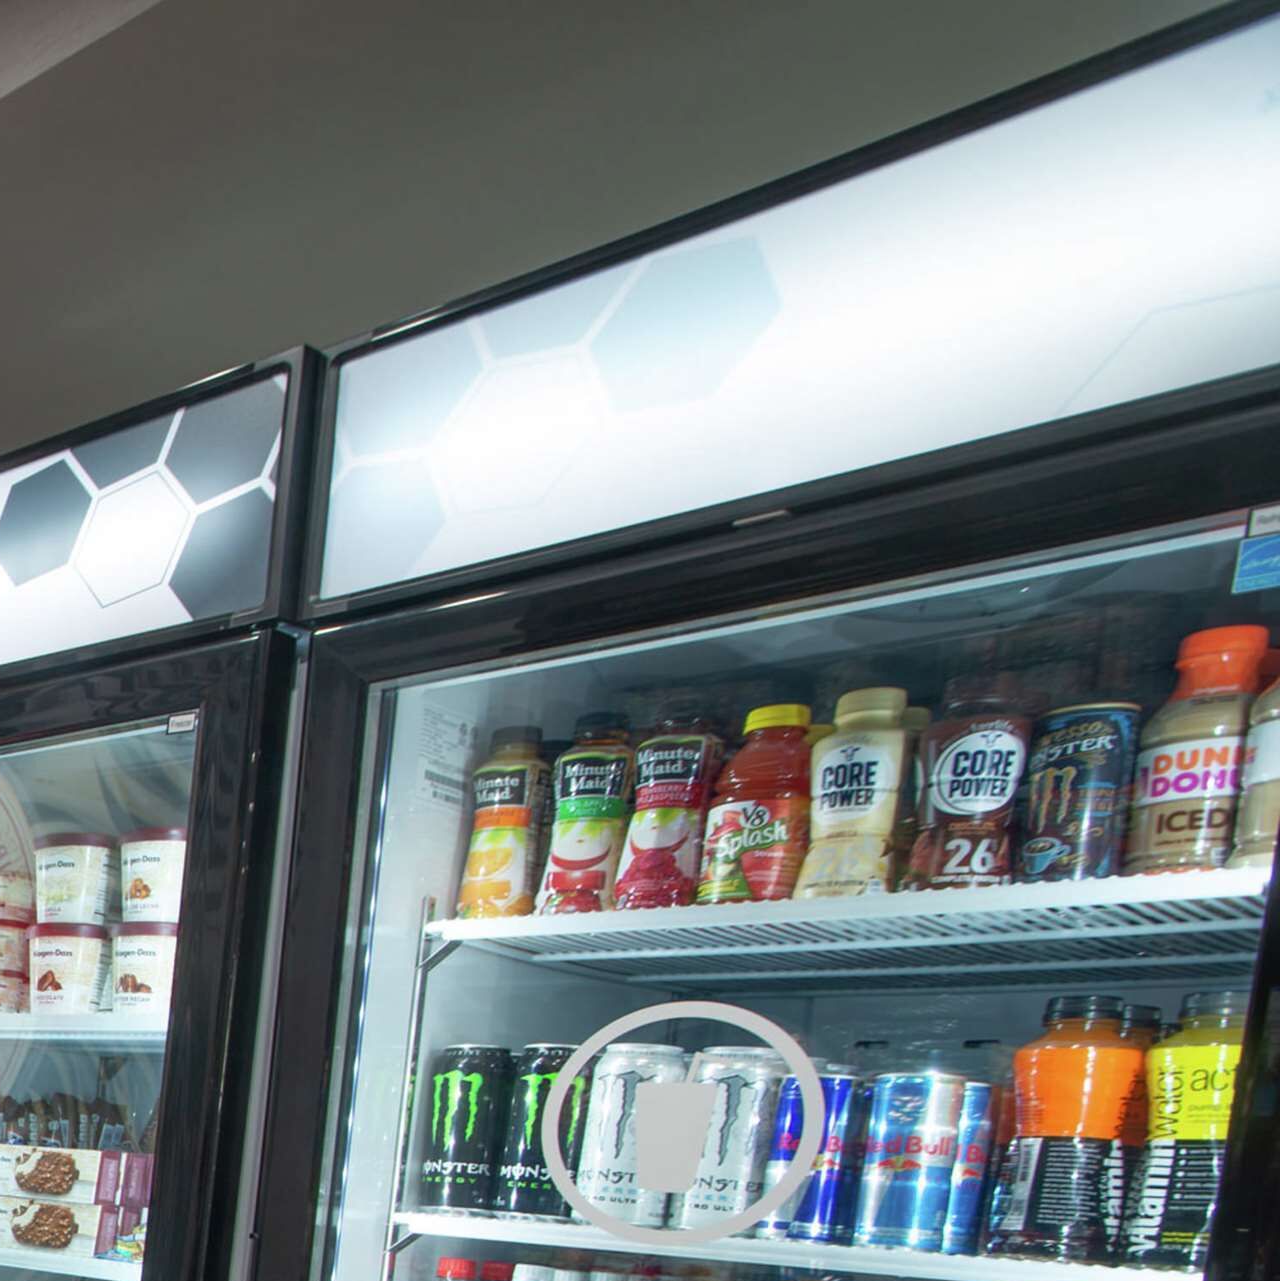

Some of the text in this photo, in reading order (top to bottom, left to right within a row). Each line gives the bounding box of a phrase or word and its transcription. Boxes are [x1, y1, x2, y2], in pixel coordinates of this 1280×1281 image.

[820, 760, 879, 791] CORE
[951, 749, 1017, 778] CORE
[819, 787, 875, 811] POWER
[741, 804, 769, 826] V8
[1155, 807, 1230, 835] ICED
[716, 820, 789, 860] Splash
[904, 1135, 954, 1156] Bull
[422, 1159, 491, 1177] ONSTER
[506, 1181, 552, 1190] ENER
